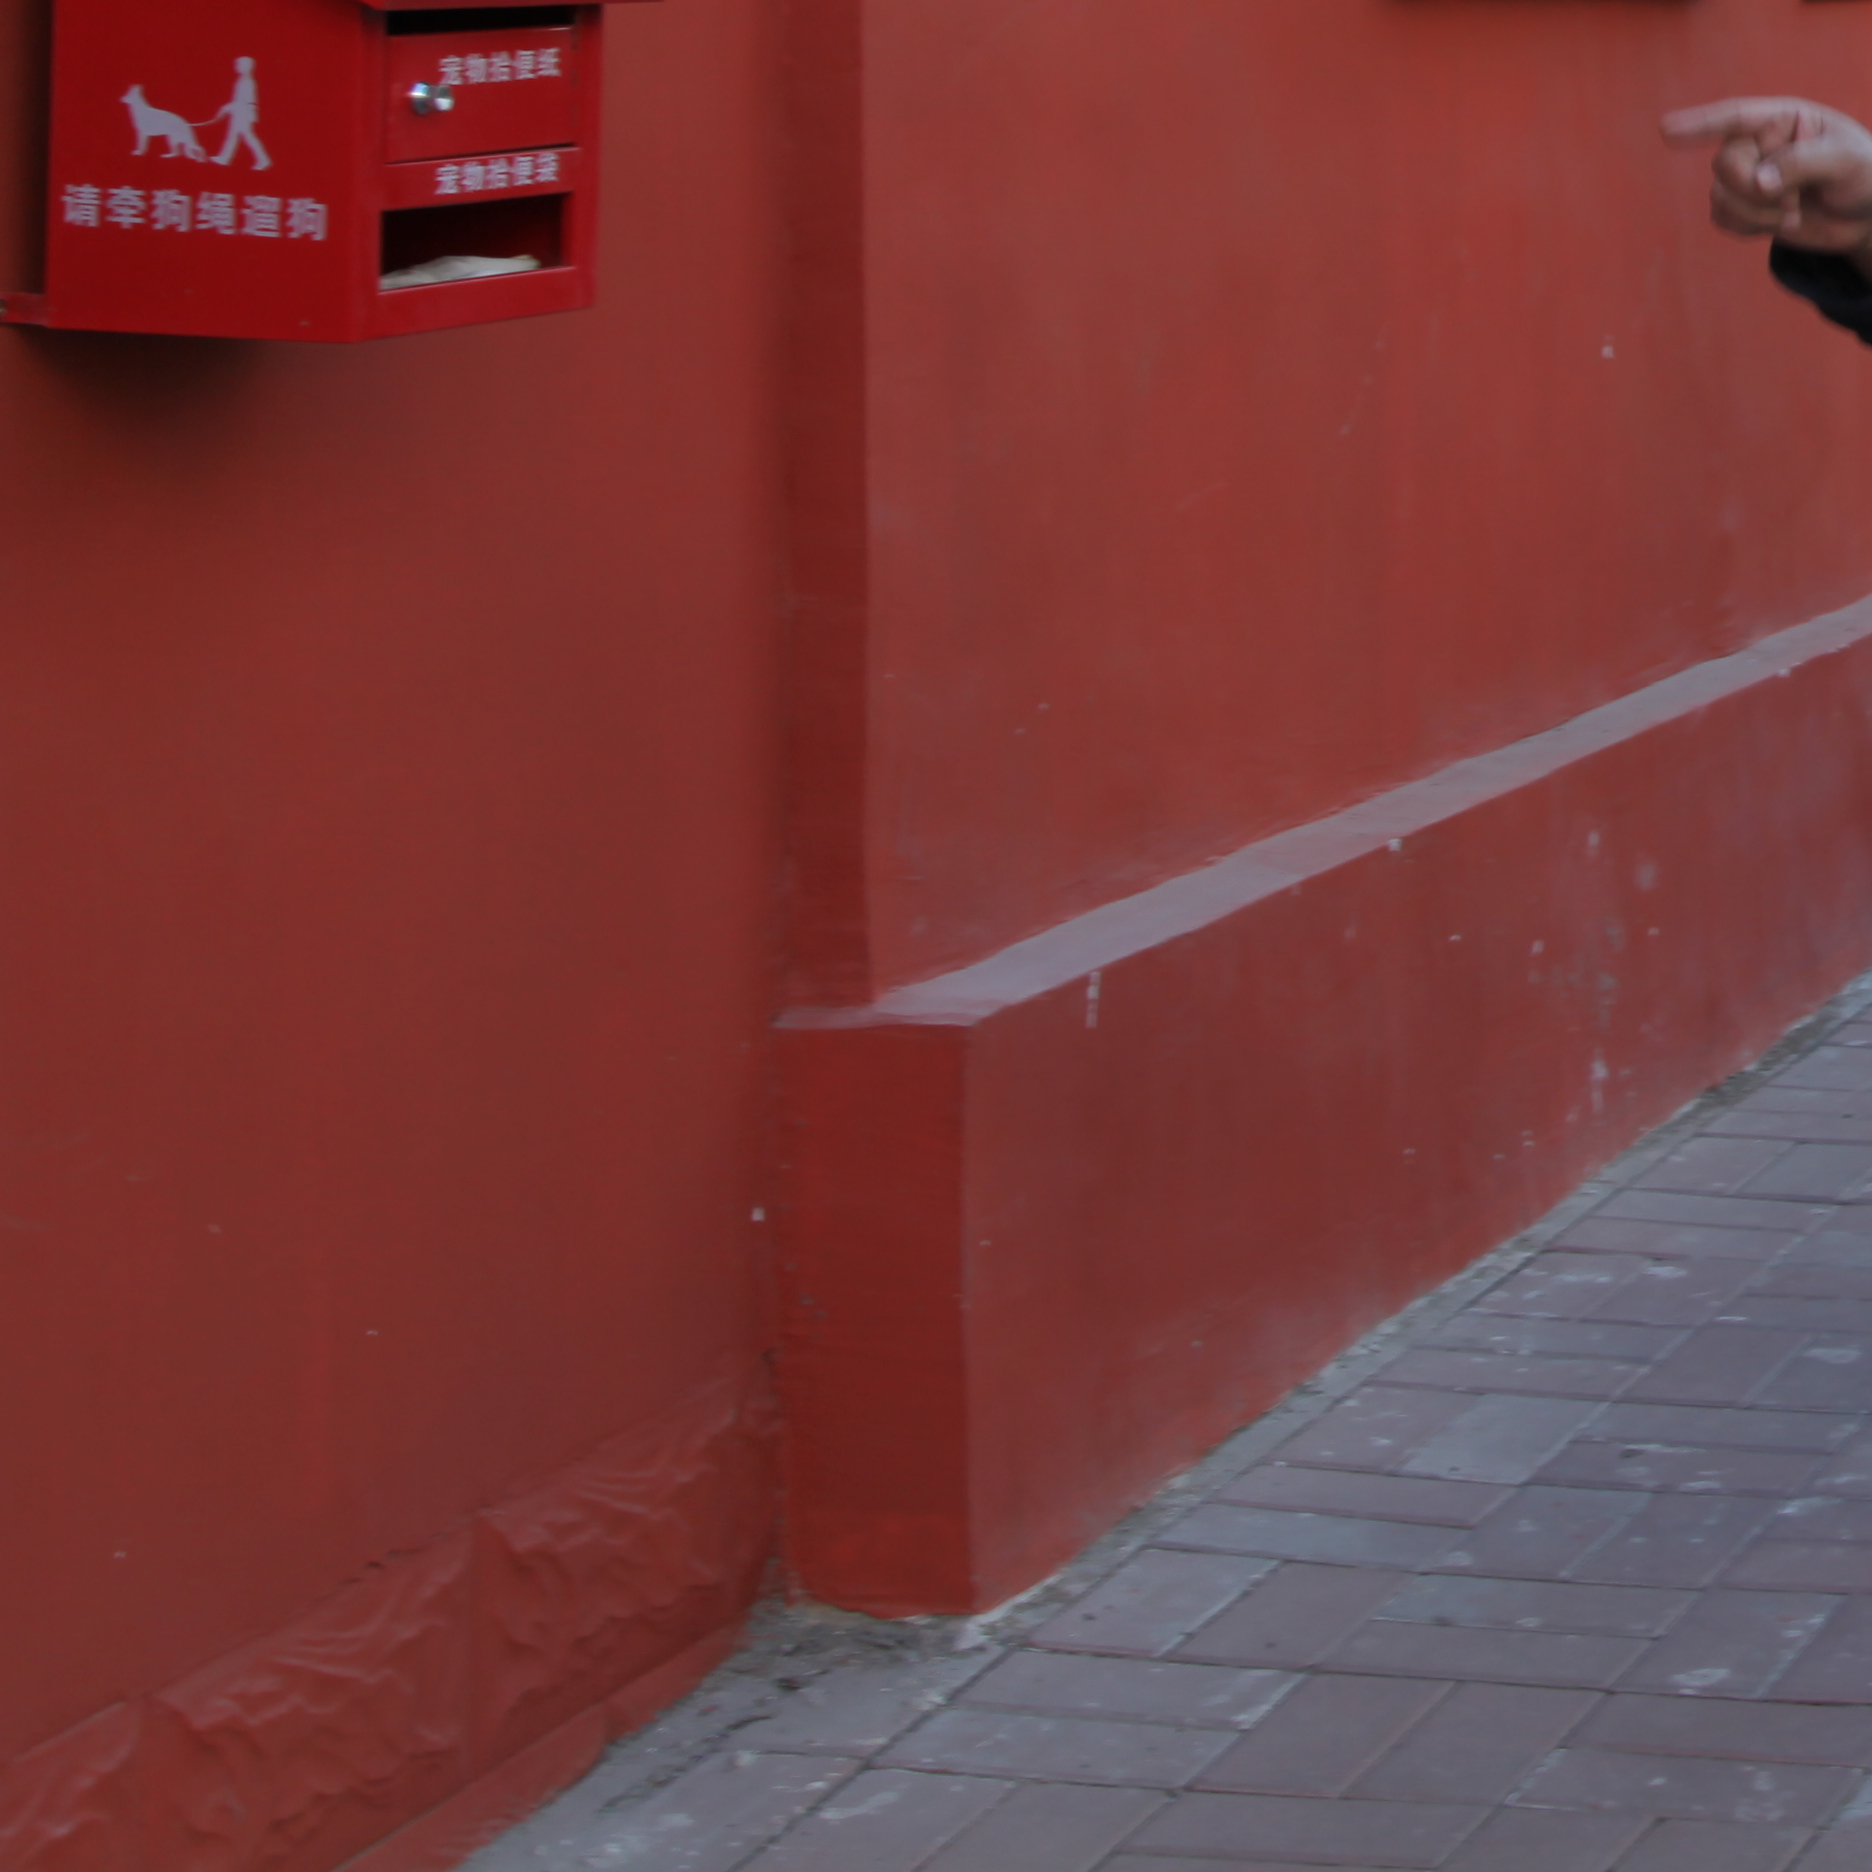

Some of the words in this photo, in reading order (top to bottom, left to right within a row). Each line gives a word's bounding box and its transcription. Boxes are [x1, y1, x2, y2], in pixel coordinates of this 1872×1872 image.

[438, 47, 563, 86] 宠物拾便纸
[434, 152, 560, 195] 宠物拾便袋
[60, 183, 329, 242] 请牵狗绳遛狗
